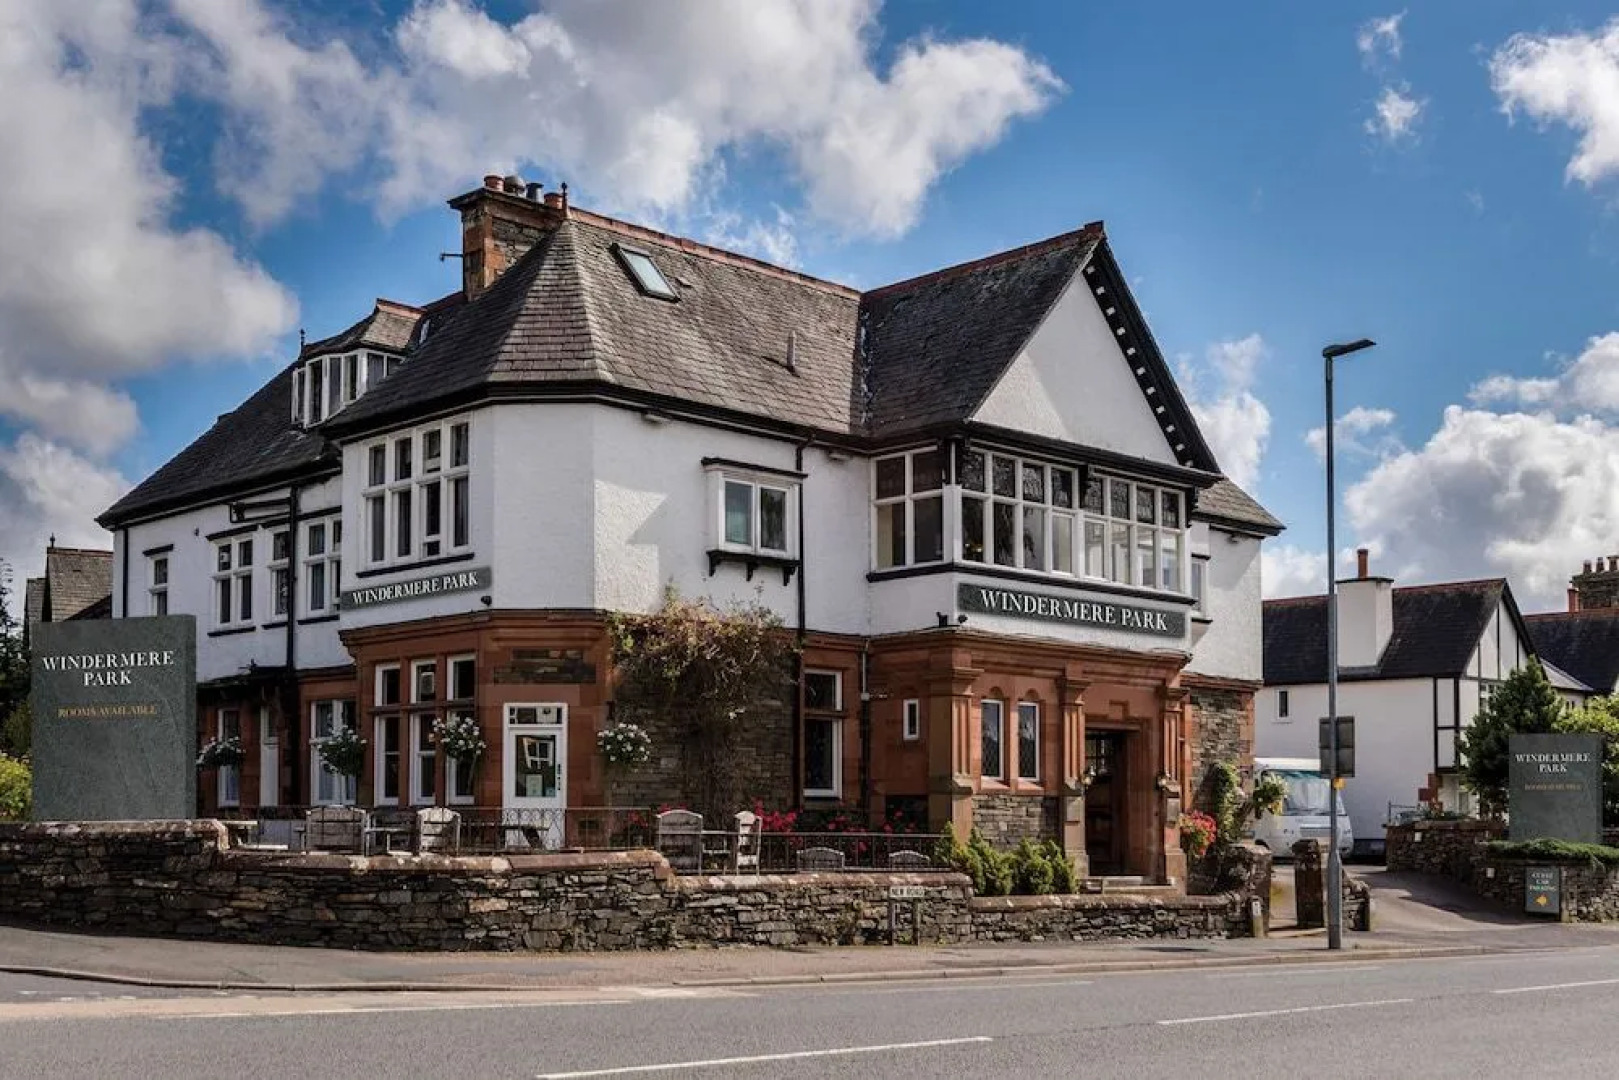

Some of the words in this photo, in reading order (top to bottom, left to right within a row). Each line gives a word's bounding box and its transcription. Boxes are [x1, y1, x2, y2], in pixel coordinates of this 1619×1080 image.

[352, 577, 440, 604] WINDERMERE
[442, 571, 479, 590] PARK
[980, 589, 1117, 624] WINDERMERE
[1121, 607, 1168, 631] PARK
[42, 650, 175, 671] WINDERMERE
[83, 670, 132, 686] PARK
[1515, 753, 1591, 763] WINDERMERE
[1539, 763, 1568, 773] PARK
